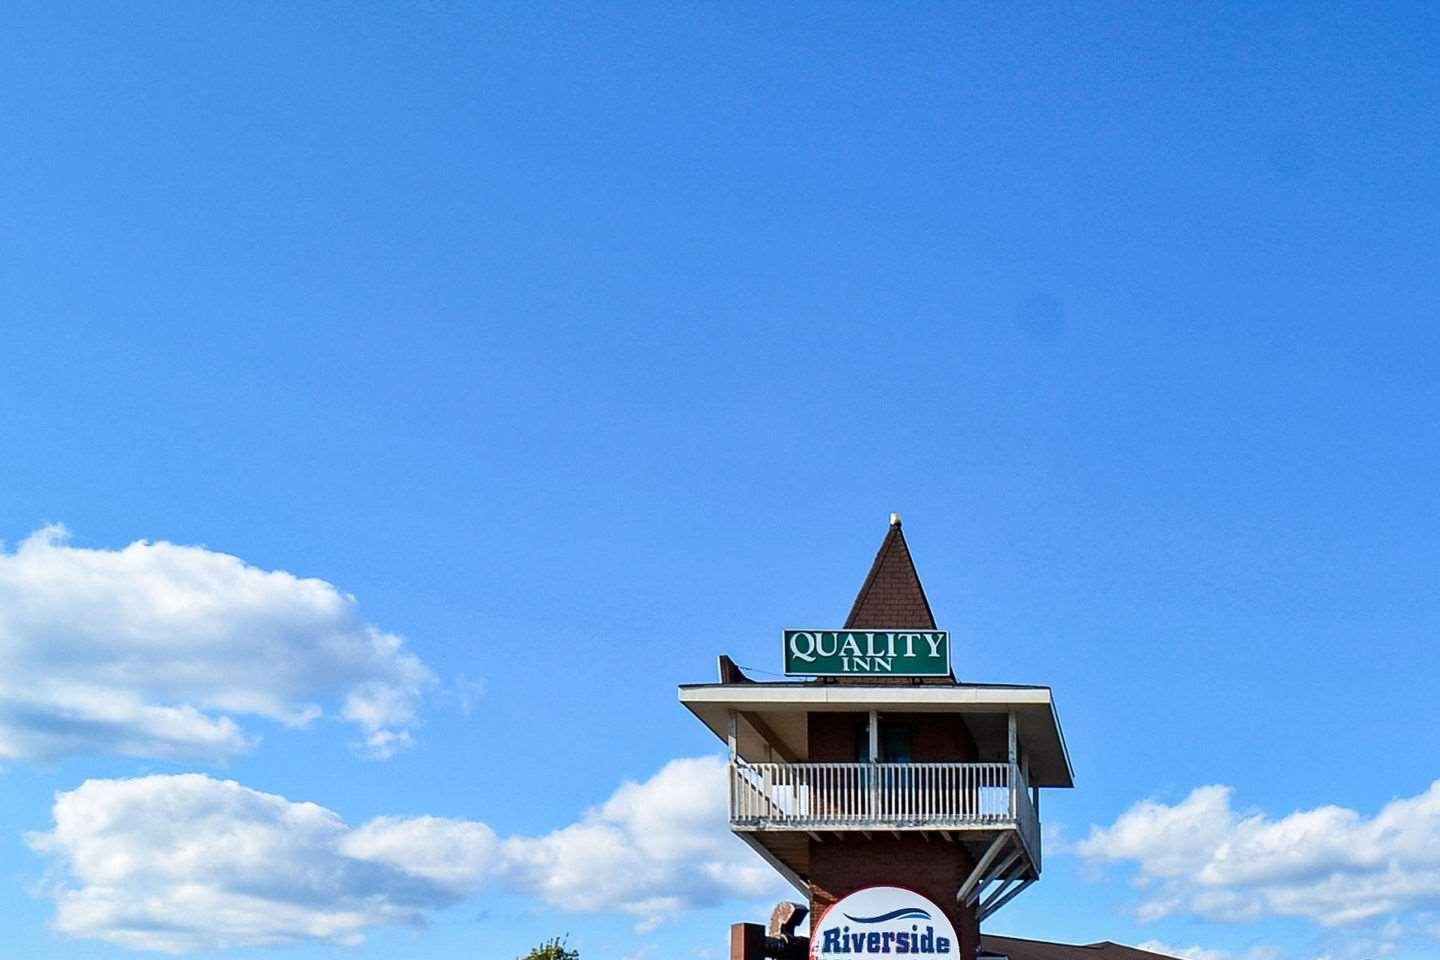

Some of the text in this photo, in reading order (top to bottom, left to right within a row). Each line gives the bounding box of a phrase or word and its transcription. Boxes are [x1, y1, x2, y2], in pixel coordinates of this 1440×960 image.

[790, 632, 945, 662] QUALITY
[842, 657, 894, 672] INN
[822, 924, 950, 954] Riverside
